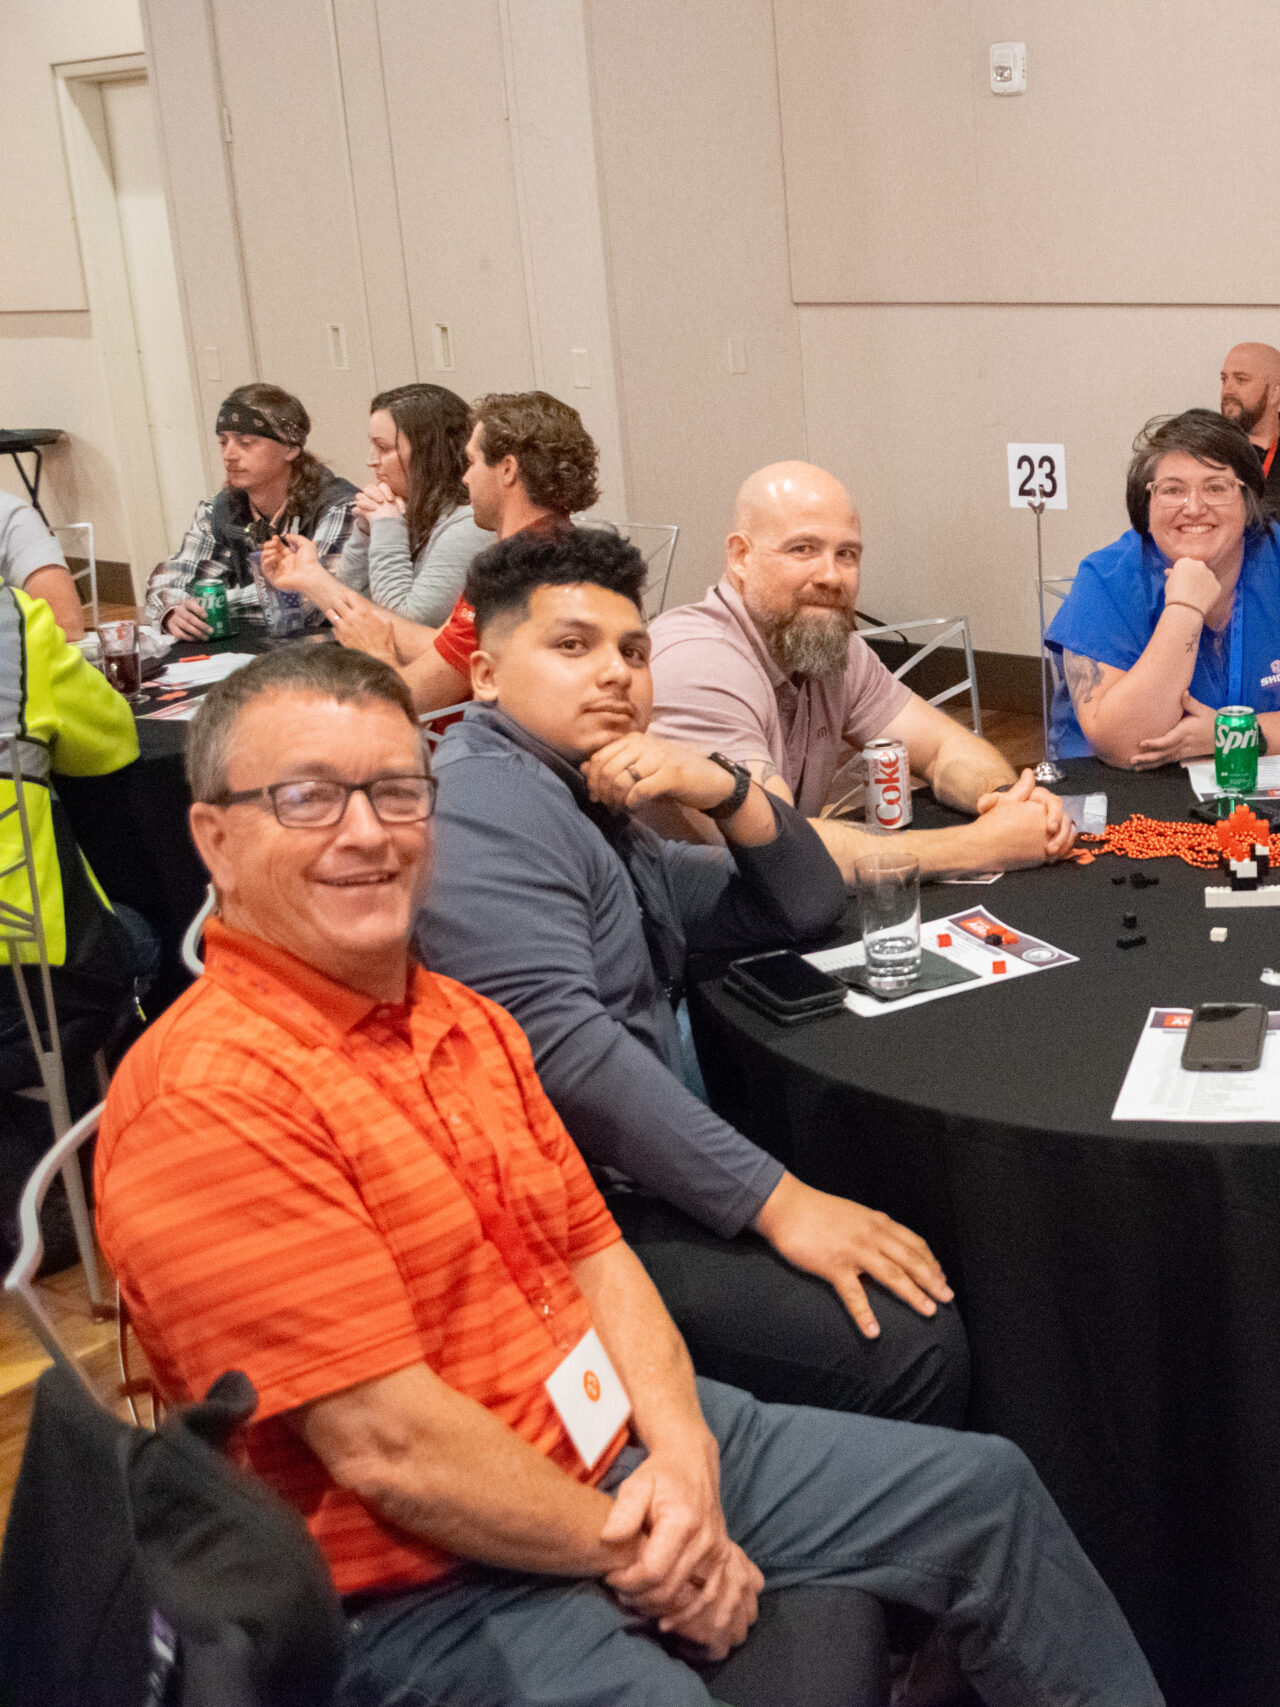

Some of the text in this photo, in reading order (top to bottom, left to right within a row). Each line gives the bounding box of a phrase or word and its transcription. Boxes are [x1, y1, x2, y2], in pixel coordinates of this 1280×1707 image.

[1017, 455, 1057, 498] 23
[1215, 720, 1258, 754] Spri
[874, 751, 902, 826] Coke
